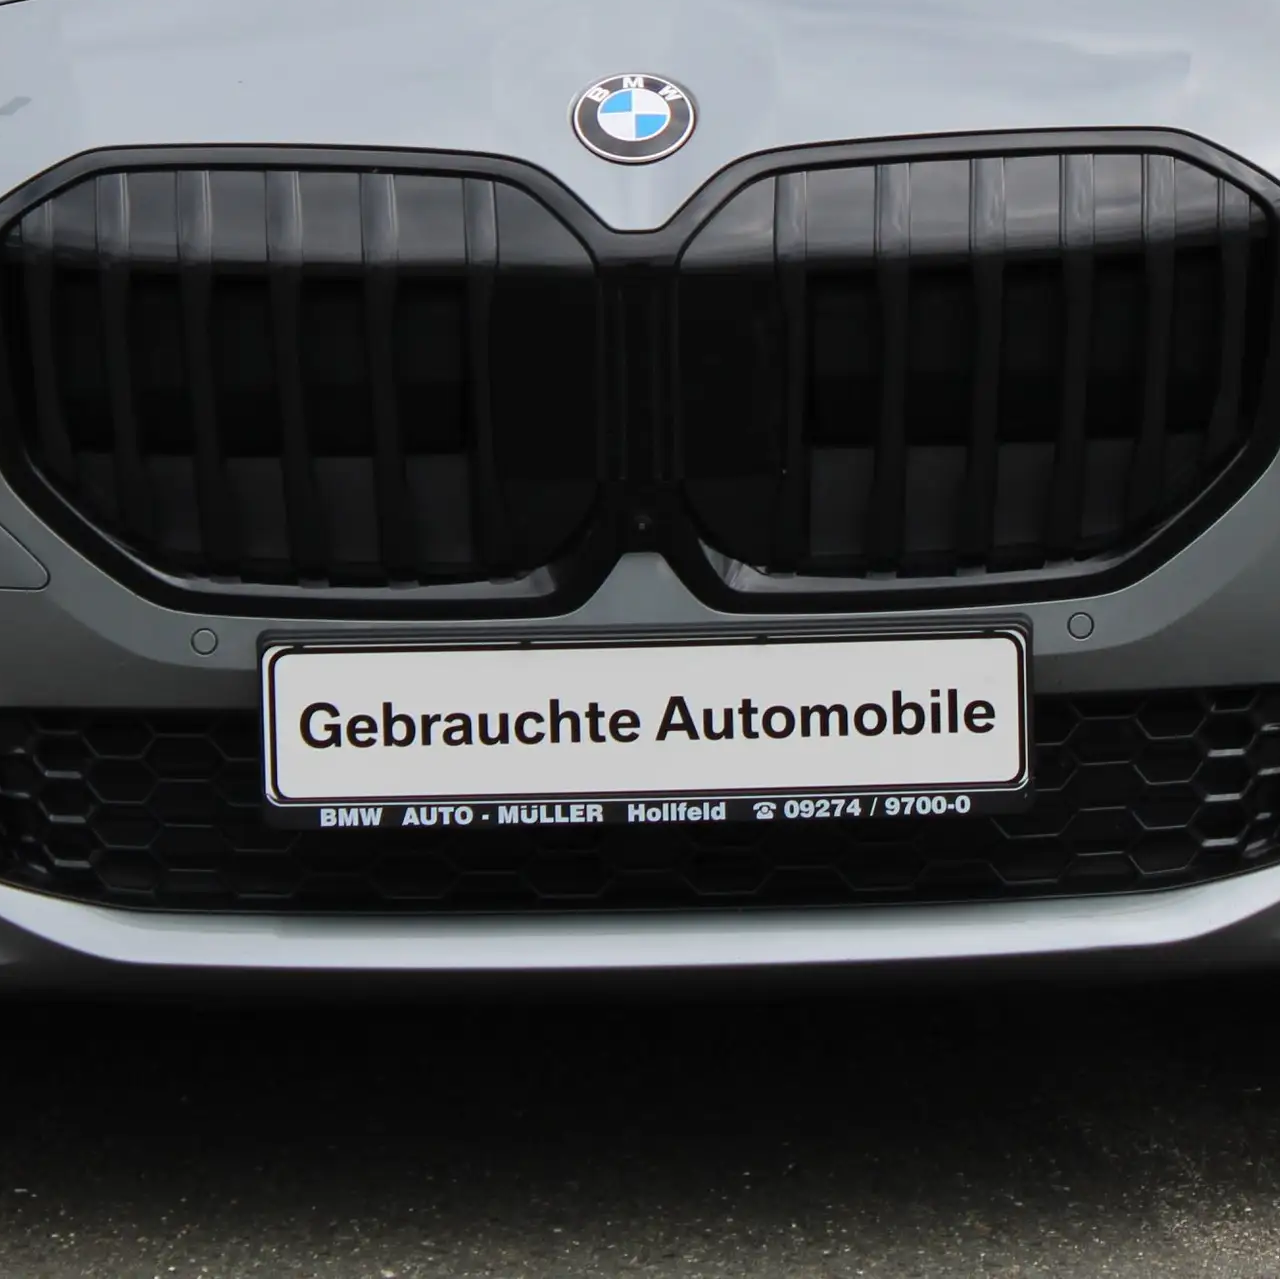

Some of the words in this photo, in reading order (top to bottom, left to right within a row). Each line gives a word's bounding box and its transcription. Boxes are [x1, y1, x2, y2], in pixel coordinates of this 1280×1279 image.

[586, 77, 684, 102] BMW
[299, 698, 641, 749] Gebrauchte
[655, 688, 996, 742] Automobile
[320, 807, 383, 827] BMW
[401, 806, 474, 826] AUTO
[498, 804, 604, 825] MÜLLER
[627, 801, 726, 823] Hollfeld
[783, 798, 862, 819] 09274
[885, 794, 971, 816] 9700-0
